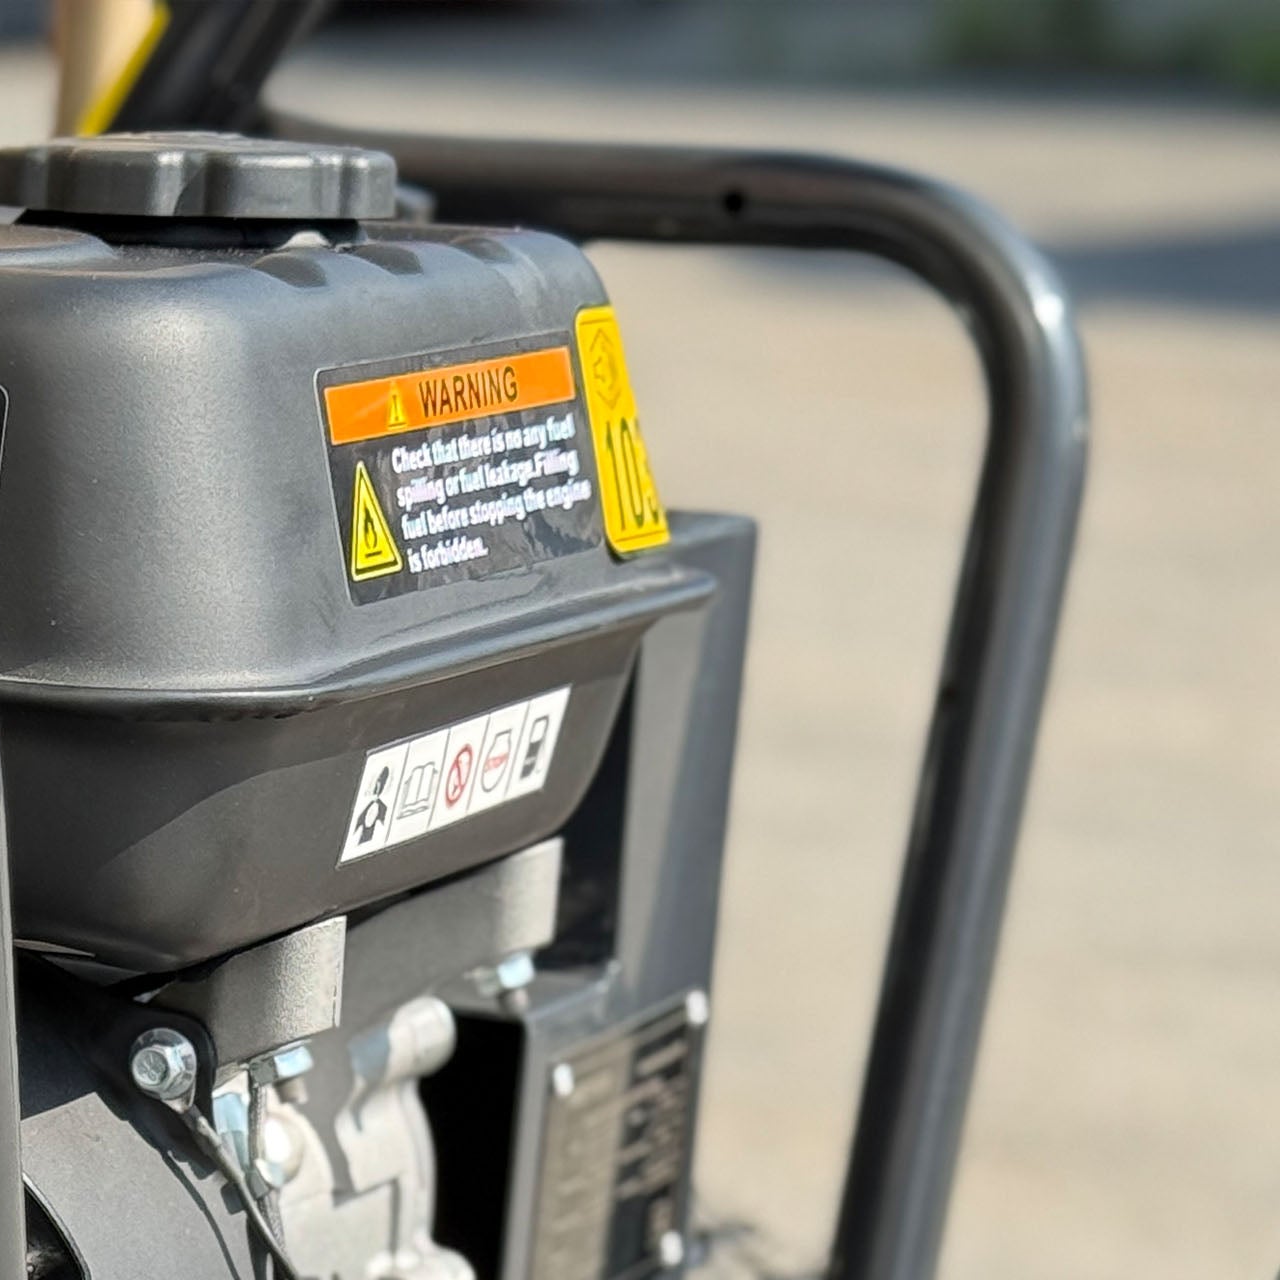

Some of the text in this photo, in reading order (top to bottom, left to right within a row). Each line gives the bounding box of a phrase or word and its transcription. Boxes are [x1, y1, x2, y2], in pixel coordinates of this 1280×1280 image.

[419, 366, 518, 417] WARNING
[392, 412, 576, 474] Check that there is no any fuel
[396, 475, 446, 512] spilling
[445, 475, 460, 497] or
[459, 467, 486, 493] fuel
[402, 477, 592, 540] fuel before stopping the engine
[407, 535, 489, 573] is forbidden.
